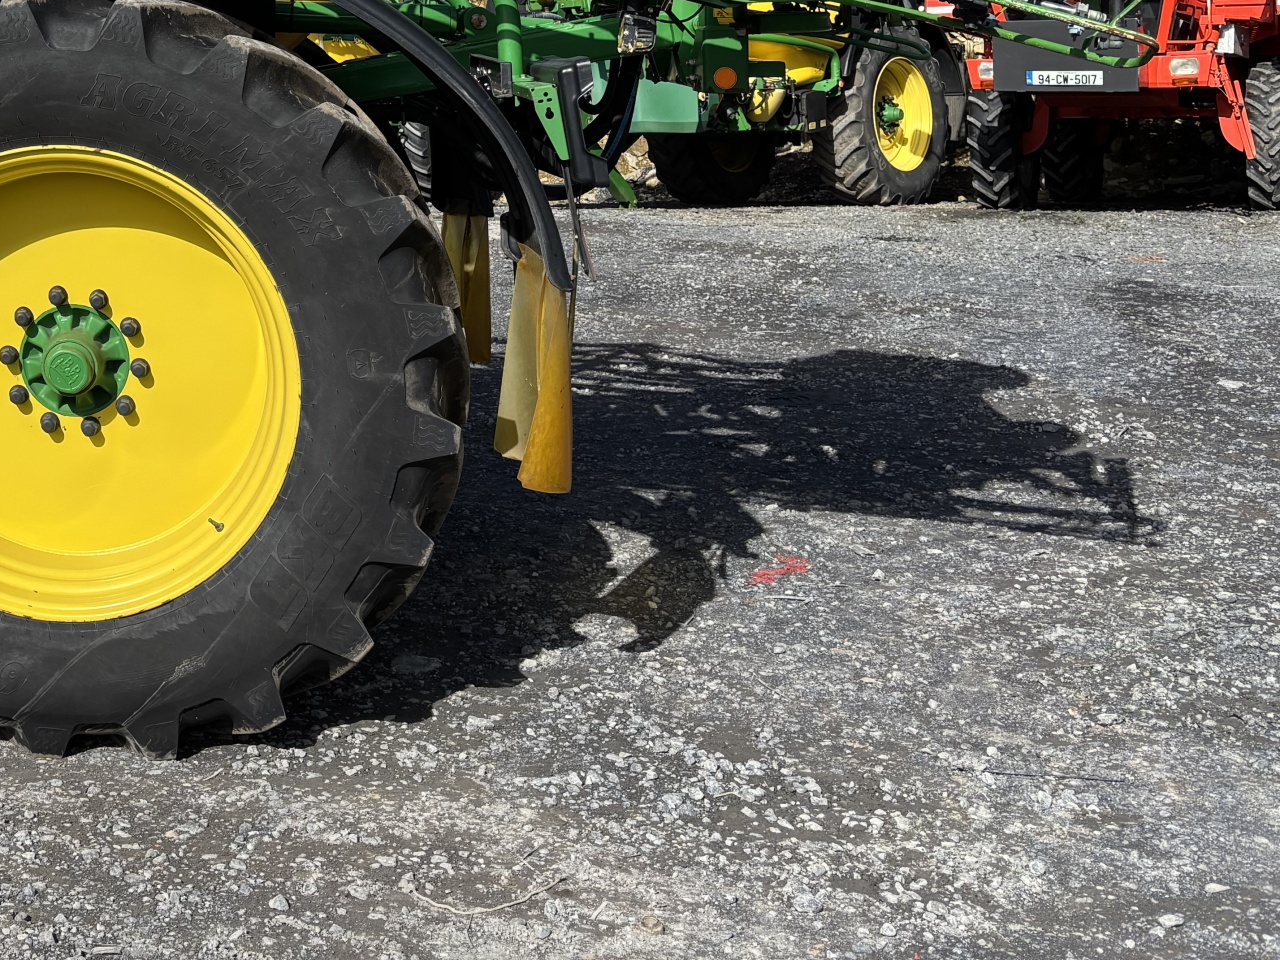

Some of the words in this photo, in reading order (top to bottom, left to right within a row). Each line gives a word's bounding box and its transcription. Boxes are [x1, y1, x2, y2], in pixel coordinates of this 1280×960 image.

[1038, 74, 1097, 85] 94-CW-5017
[160, 134, 203, 162] RT
[201, 157, 249, 193] 657
[249, 473, 362, 633] BKT
